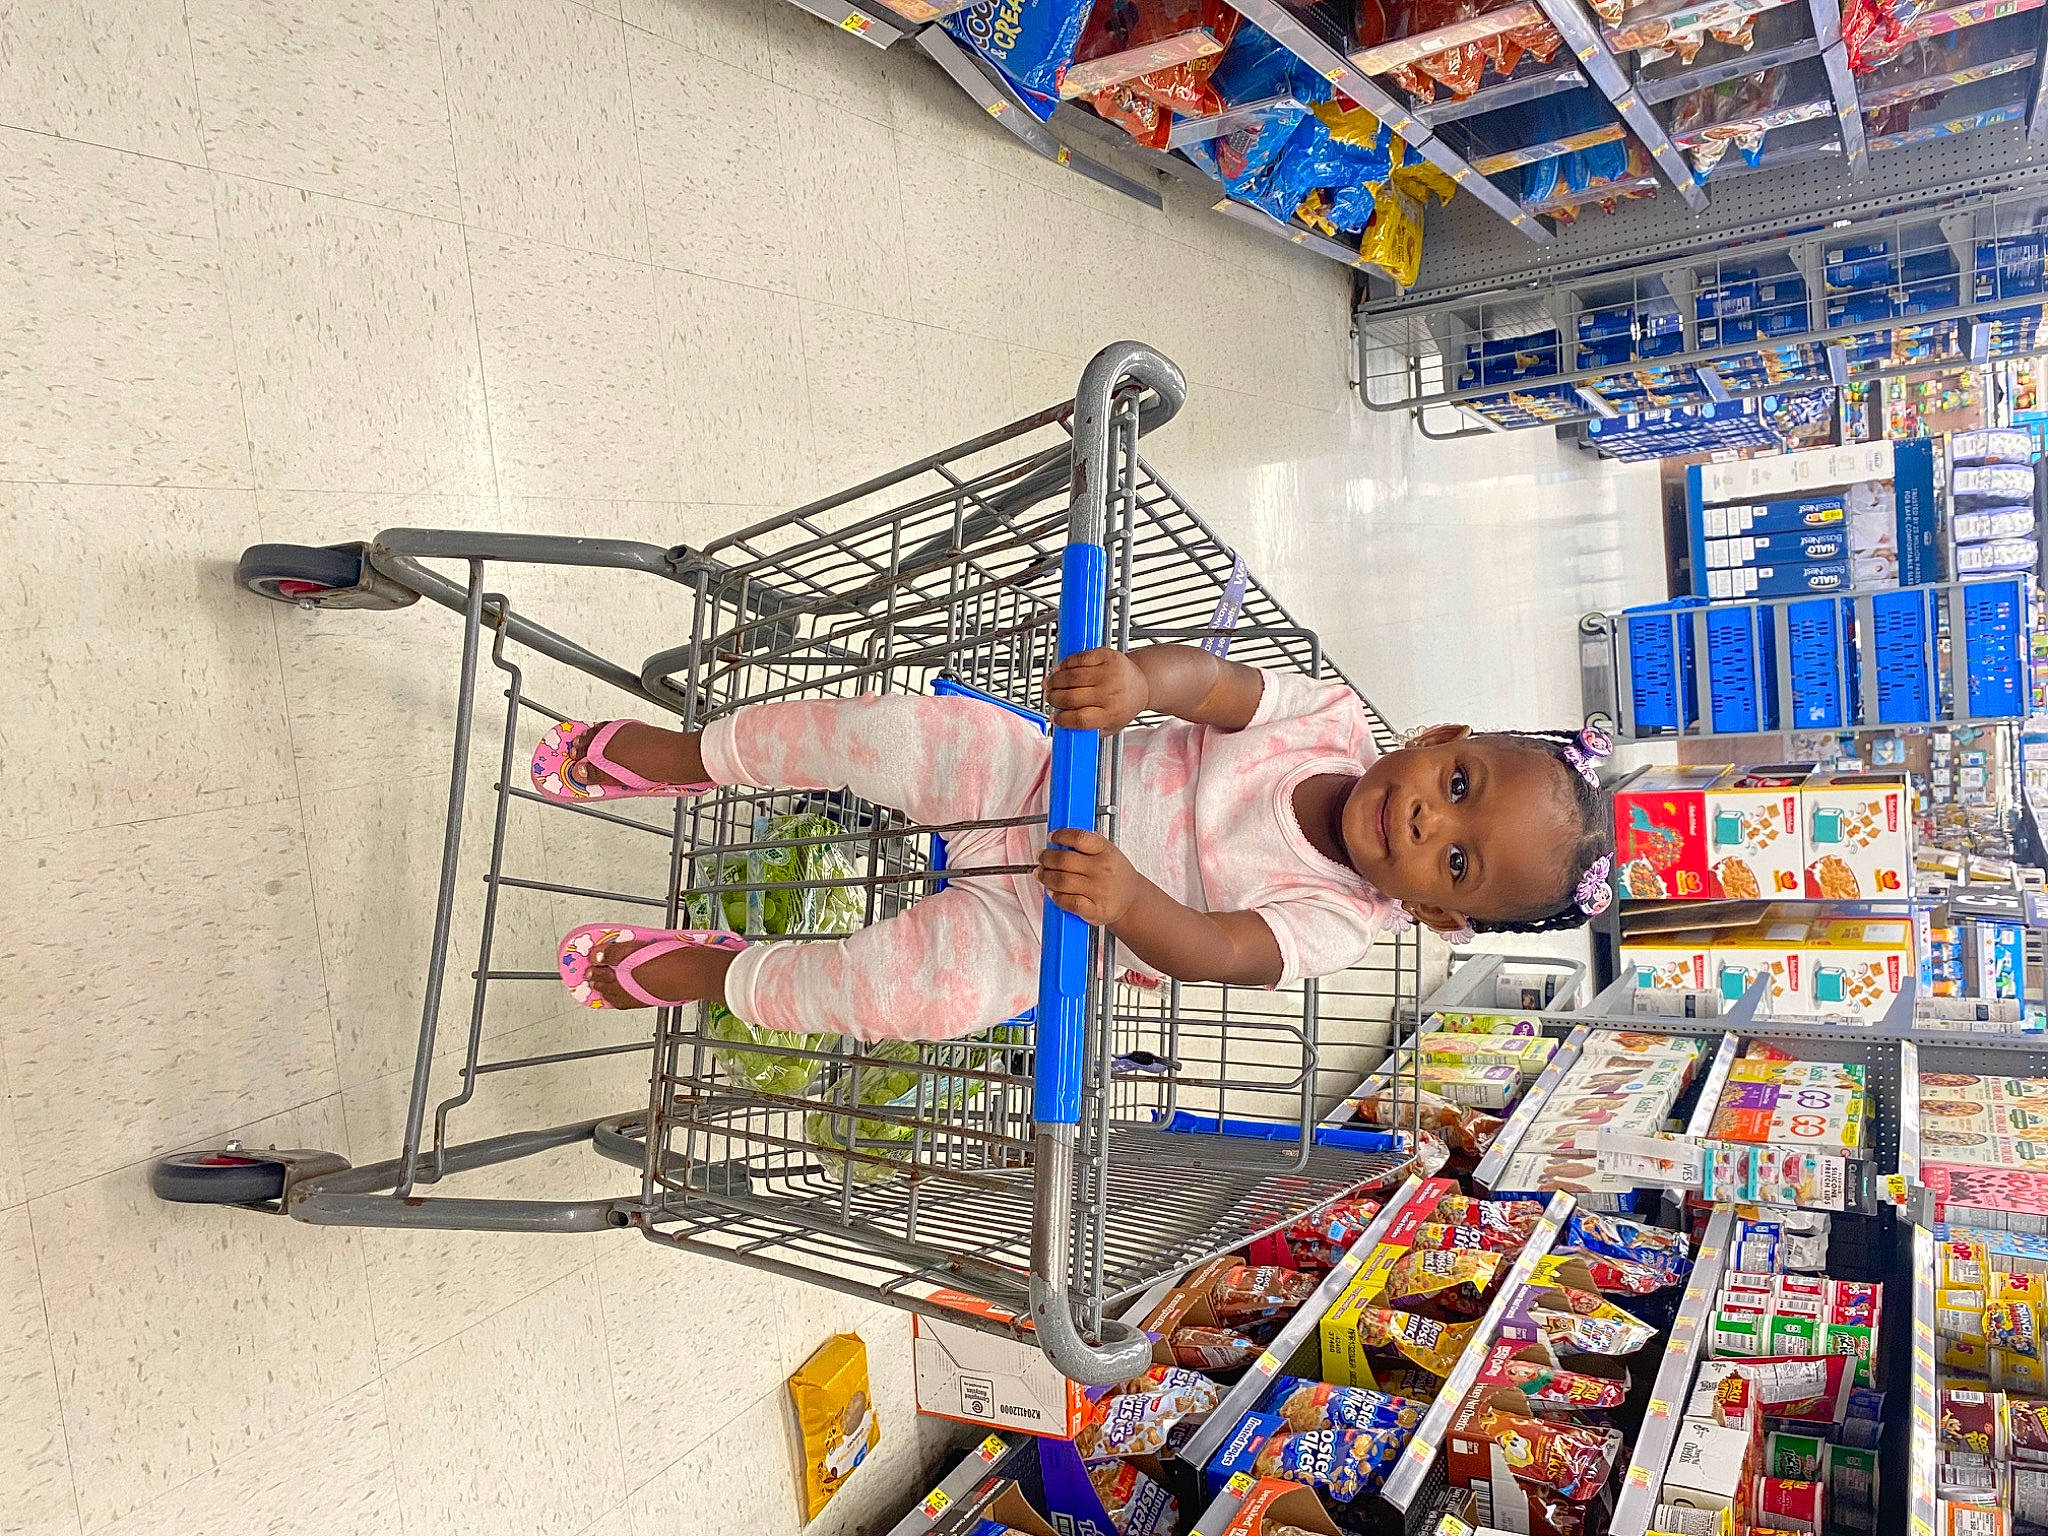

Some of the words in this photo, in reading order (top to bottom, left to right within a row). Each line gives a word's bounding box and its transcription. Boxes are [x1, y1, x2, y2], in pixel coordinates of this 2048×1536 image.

[1808, 543, 1836, 554] HALO
[1810, 574, 1839, 585] HALO
[1830, 1167, 1838, 1198] SILICONE
[1847, 1164, 1858, 1206] Cuisinart
[1264, 1268, 1275, 1287] Cocoa
[2016, 1303, 2032, 1338] CRUNCH
[1426, 1323, 1443, 1349] Berry
[1834, 1331, 1848, 1355] JACK
[1468, 1383, 1488, 1399] Honey
[1463, 1399, 1480, 1409] Nut
[1453, 1409, 1475, 1431] Cheerios
[1679, 1442, 1698, 1464] Cheerios
[1257, 1489, 1274, 1503] bear
[1241, 1503, 1262, 1527] naked
